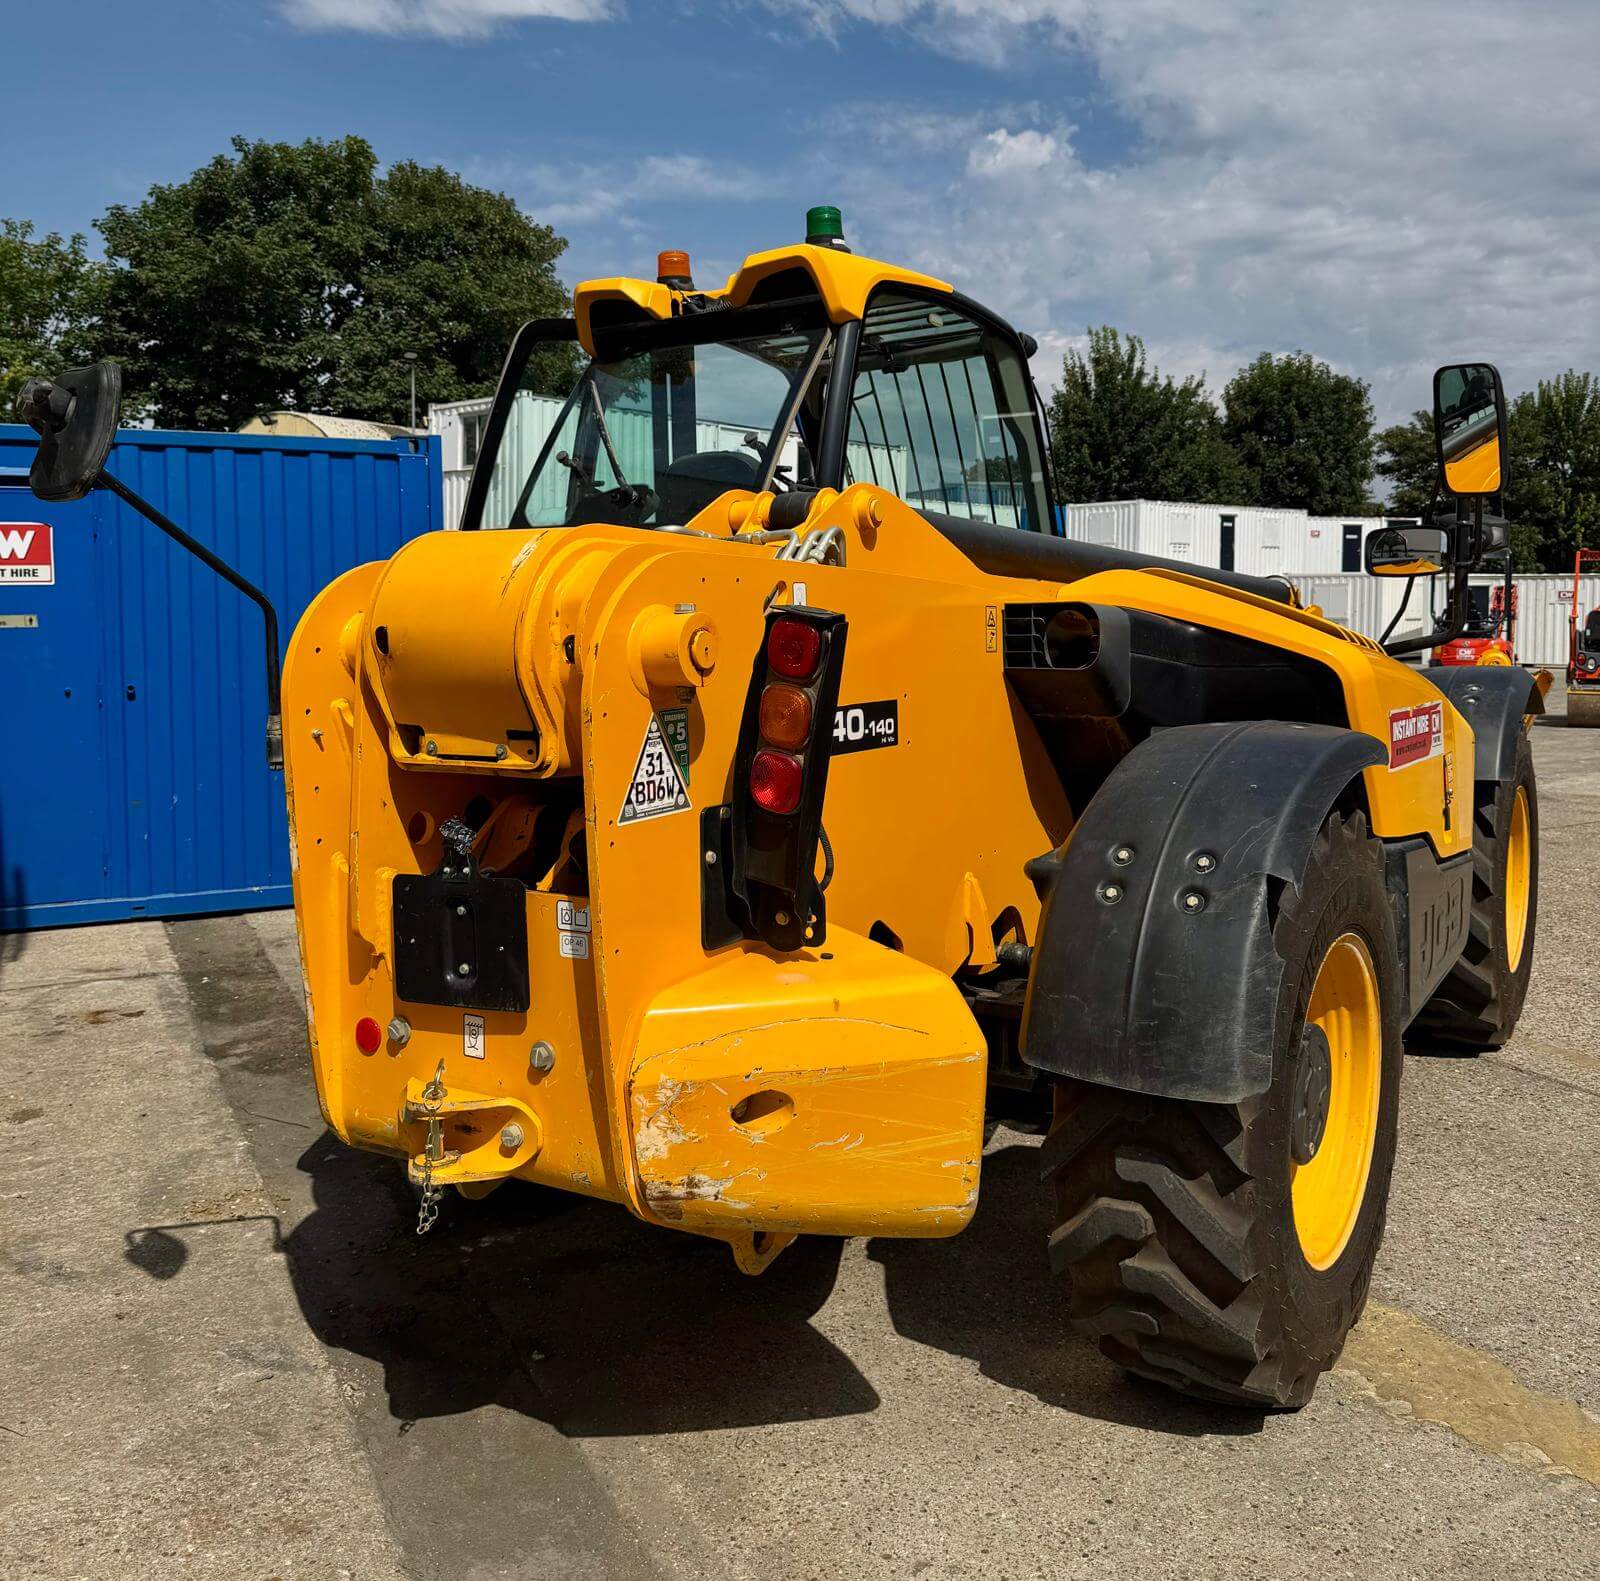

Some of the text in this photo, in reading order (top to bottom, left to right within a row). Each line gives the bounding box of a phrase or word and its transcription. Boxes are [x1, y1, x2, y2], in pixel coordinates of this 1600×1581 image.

[11, 568, 39, 577] HIRE
[676, 722, 686, 741] 5
[1393, 714, 1430, 742] INSTANT HIRE
[645, 752, 665, 777] 31
[635, 776, 675, 806] BD6W
